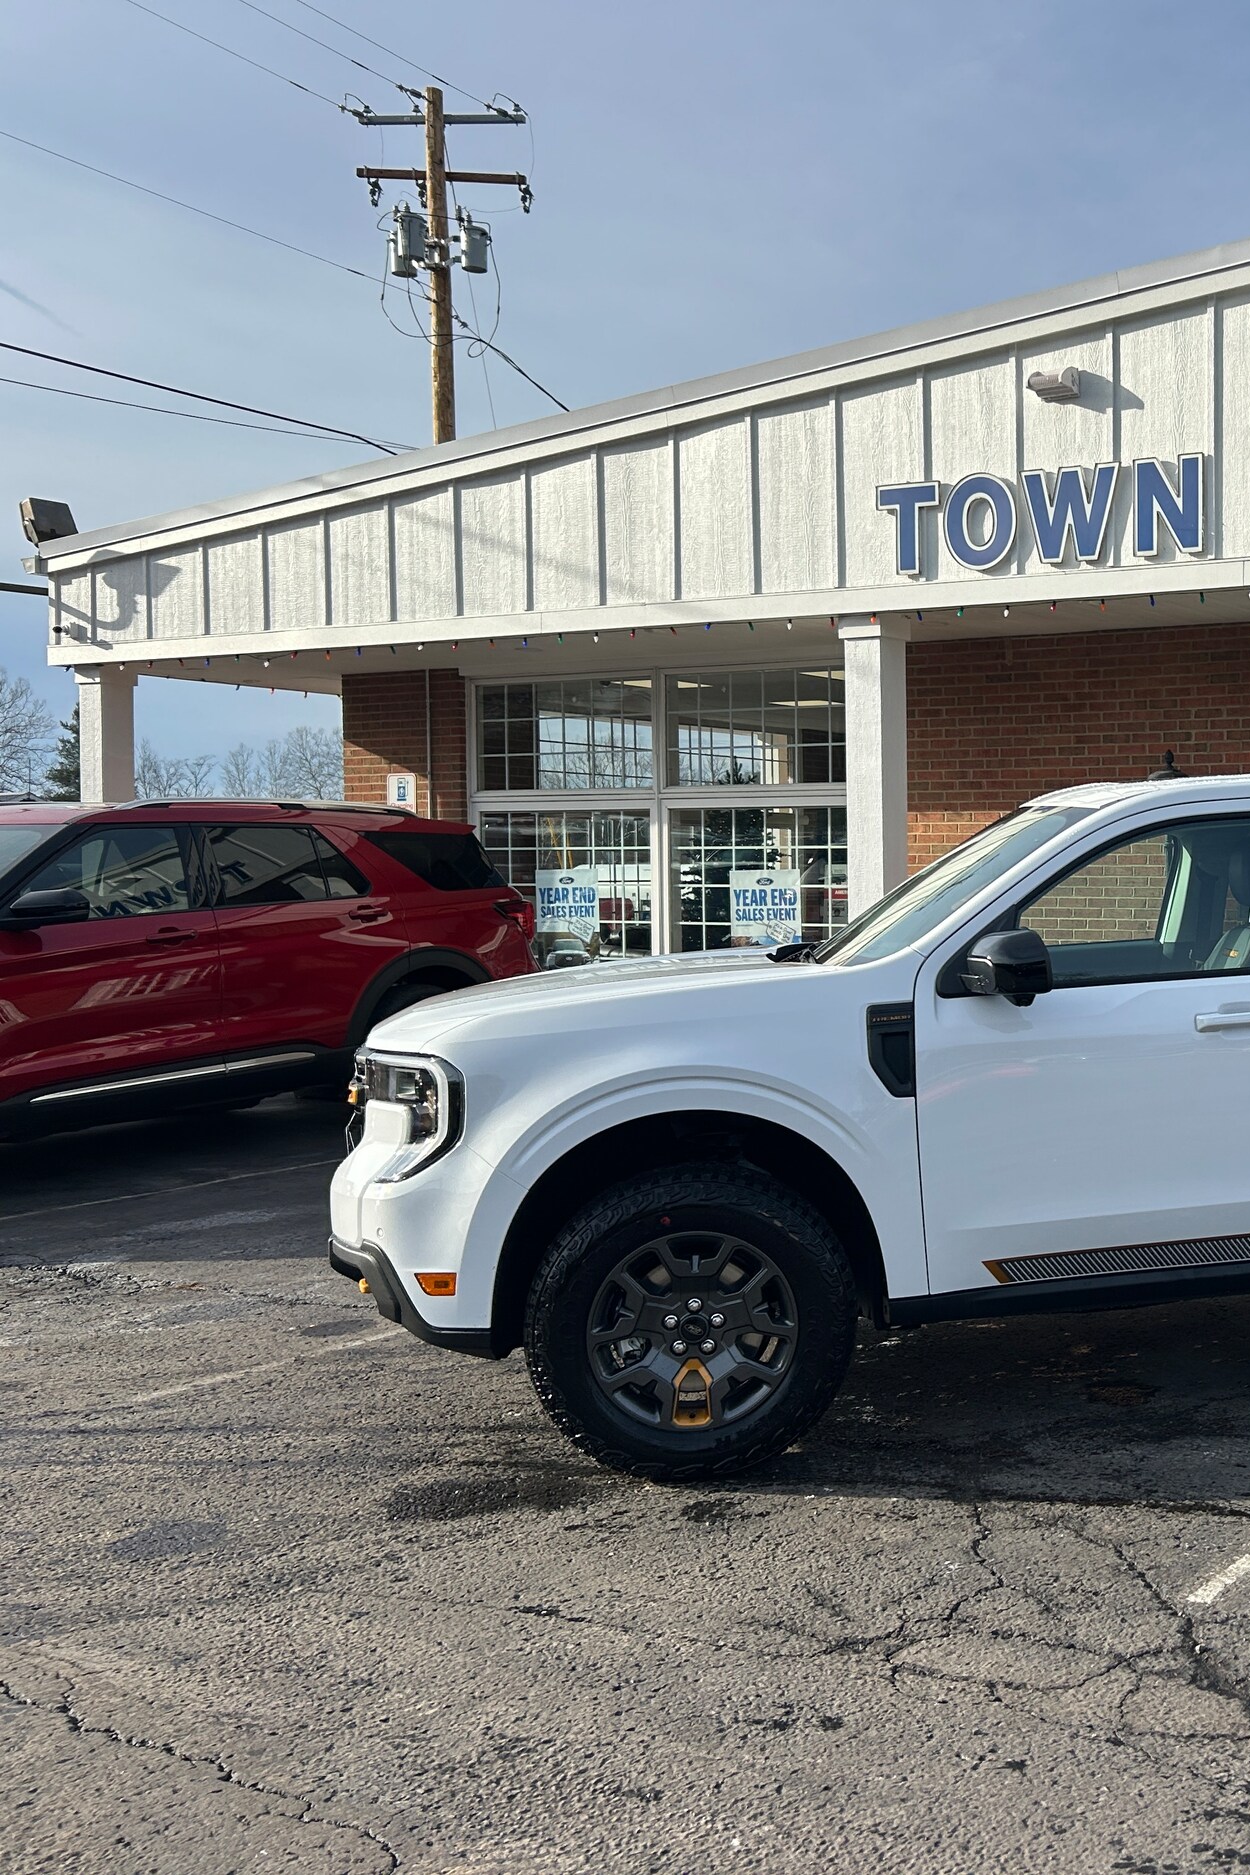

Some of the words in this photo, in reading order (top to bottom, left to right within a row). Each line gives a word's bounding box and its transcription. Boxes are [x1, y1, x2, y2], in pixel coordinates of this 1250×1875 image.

[875, 452, 1206, 576] TOWN
[538, 888, 570, 904] YEAR
[572, 887, 596, 904] END
[733, 889, 768, 906] YEAR
[770, 888, 798, 906] END
[540, 906, 566, 918] SALES
[568, 906, 596, 918] EVENT
[736, 908, 764, 921] SALES
[766, 908, 796, 920] EVENT
